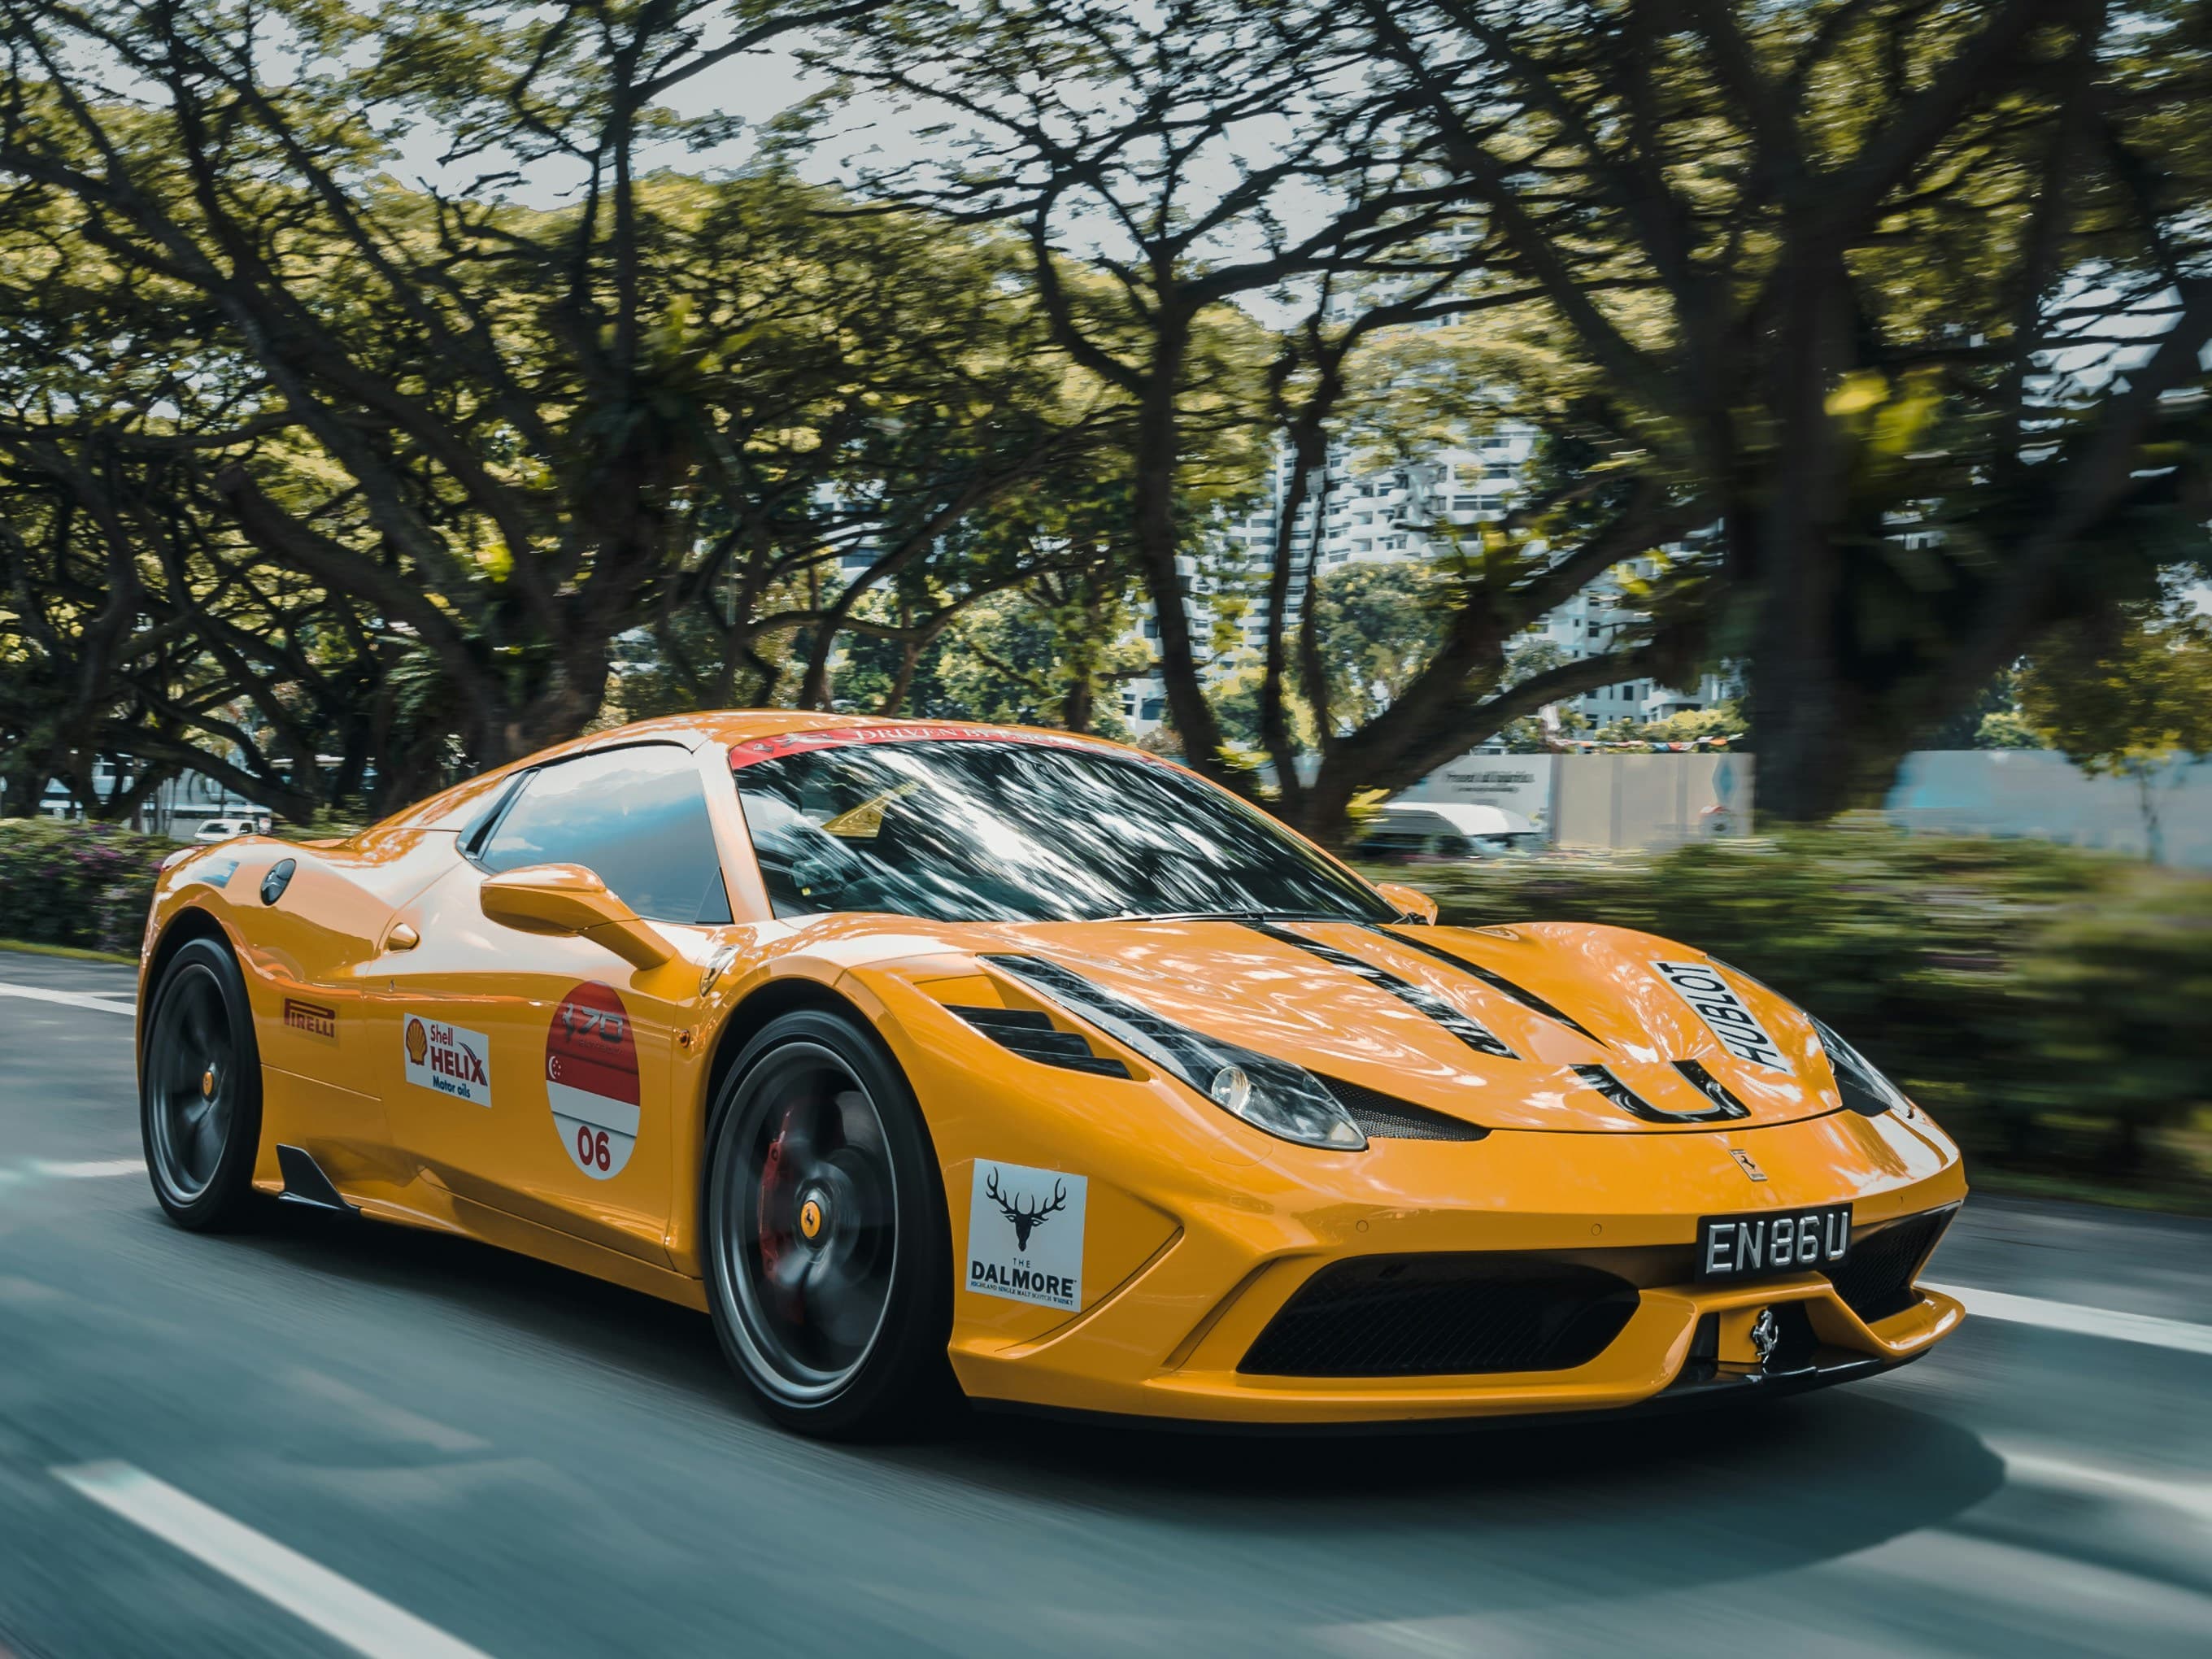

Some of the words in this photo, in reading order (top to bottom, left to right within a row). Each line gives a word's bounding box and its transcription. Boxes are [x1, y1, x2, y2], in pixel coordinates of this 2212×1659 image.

[285, 998, 335, 1039] PIRELLI
[430, 1025, 454, 1047] Shell
[578, 1005, 623, 1044] 70
[1657, 962, 1787, 1073] HUBLOT
[430, 1045, 488, 1087] HELIX
[433, 1075, 455, 1094] Motor
[457, 1083, 471, 1099] oils
[577, 1125, 611, 1172] 06
[1705, 1212, 1848, 1274] EN86U
[971, 1261, 1074, 1299] DALMORE
[1013, 1257, 1030, 1269] THE
[1017, 1289, 1030, 1298] MALT
